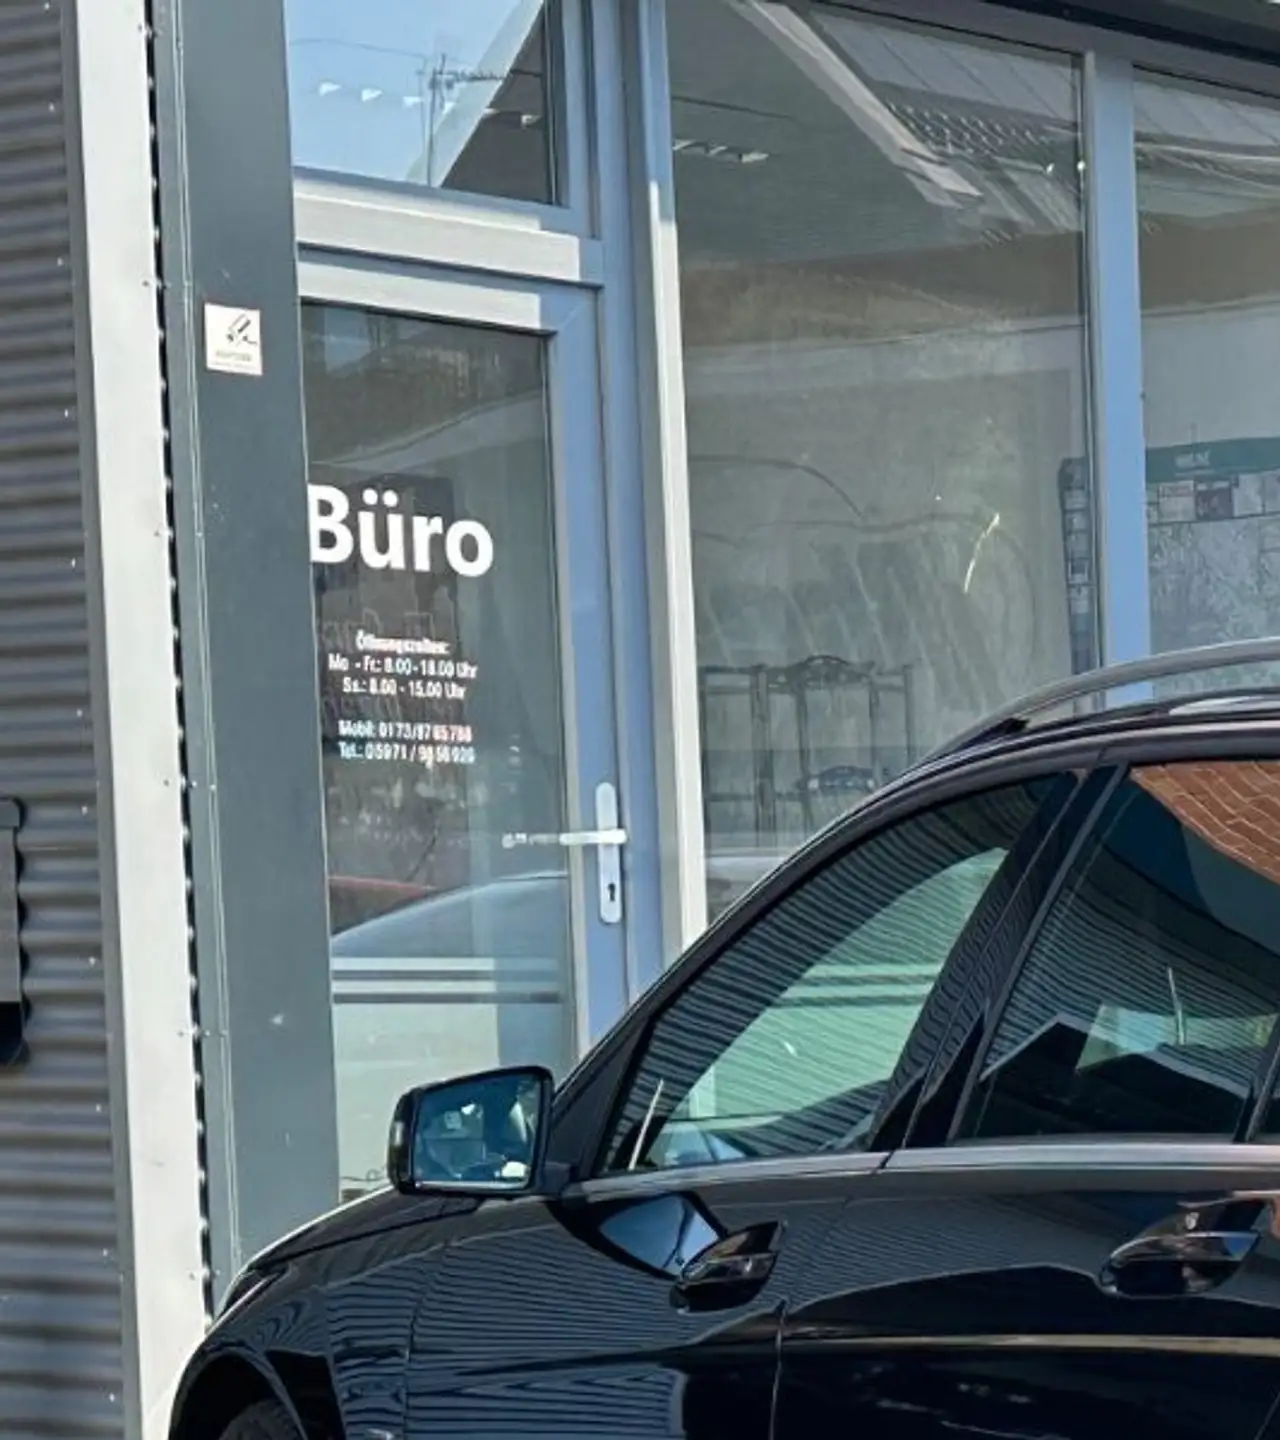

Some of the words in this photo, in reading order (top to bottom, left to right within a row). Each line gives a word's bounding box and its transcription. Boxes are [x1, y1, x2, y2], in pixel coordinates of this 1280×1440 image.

[307, 483, 494, 577] Büro
[456, 661, 478, 678] Uhr
[444, 682, 467, 699] Uhr
